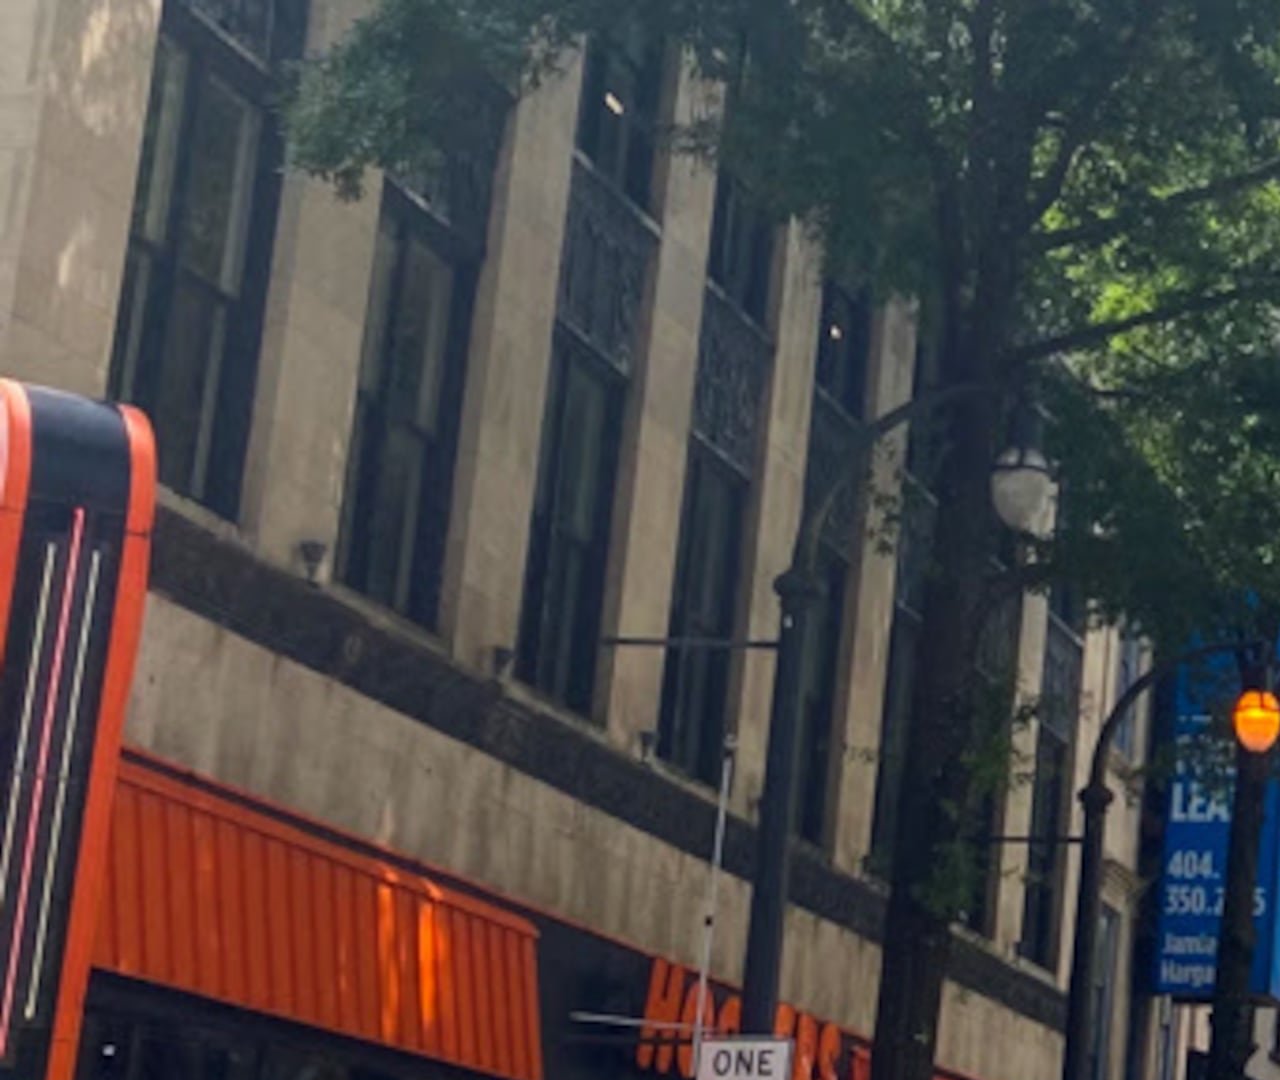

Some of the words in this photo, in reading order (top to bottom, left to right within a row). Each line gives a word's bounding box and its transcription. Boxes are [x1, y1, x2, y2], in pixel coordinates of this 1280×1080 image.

[1171, 782, 1231, 823] LEA
[1166, 849, 1222, 881] 404.
[1164, 883, 1267, 917] 350.25
[713, 1049, 775, 1078] ONE
